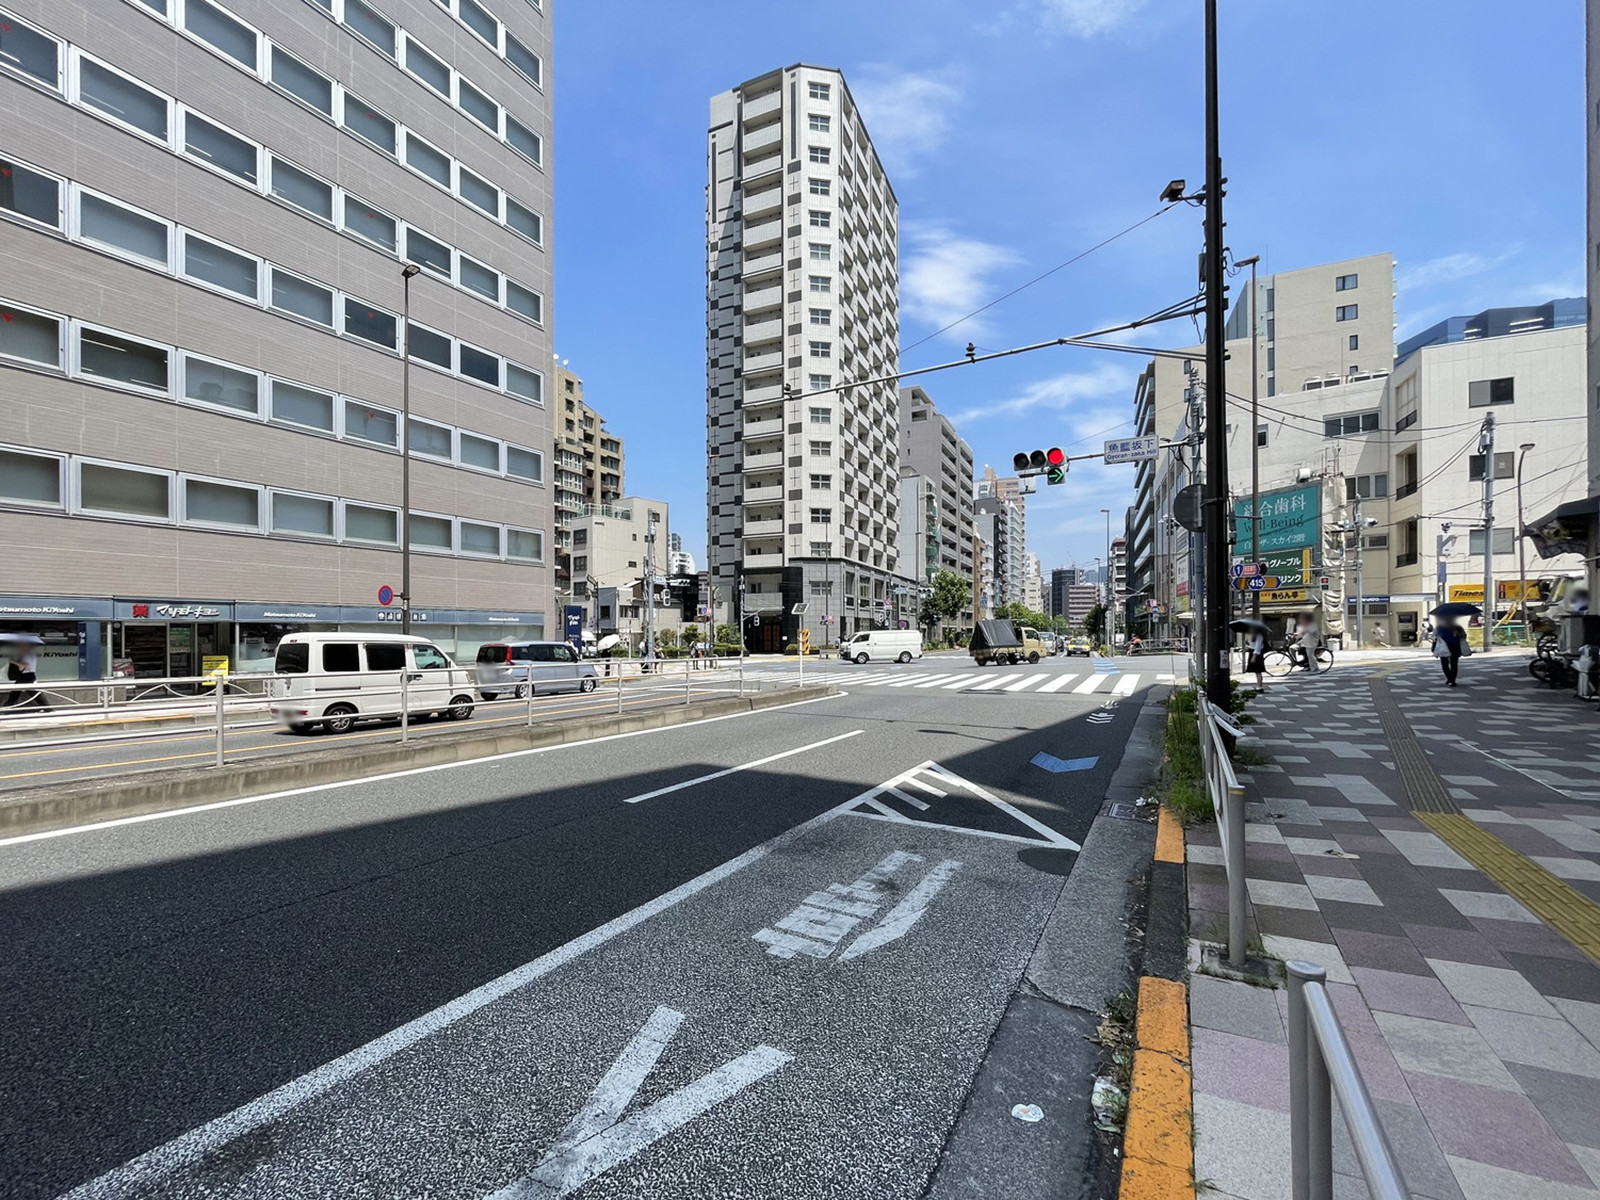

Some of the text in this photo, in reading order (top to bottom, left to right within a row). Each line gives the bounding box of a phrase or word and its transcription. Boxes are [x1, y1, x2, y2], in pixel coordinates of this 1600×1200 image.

[1107, 450, 1145, 460] Gyoran-zaka
[1244, 514, 1304, 532] Wll-Being
[1244, 533, 1305, 550] 白ザ・スカイ2階
